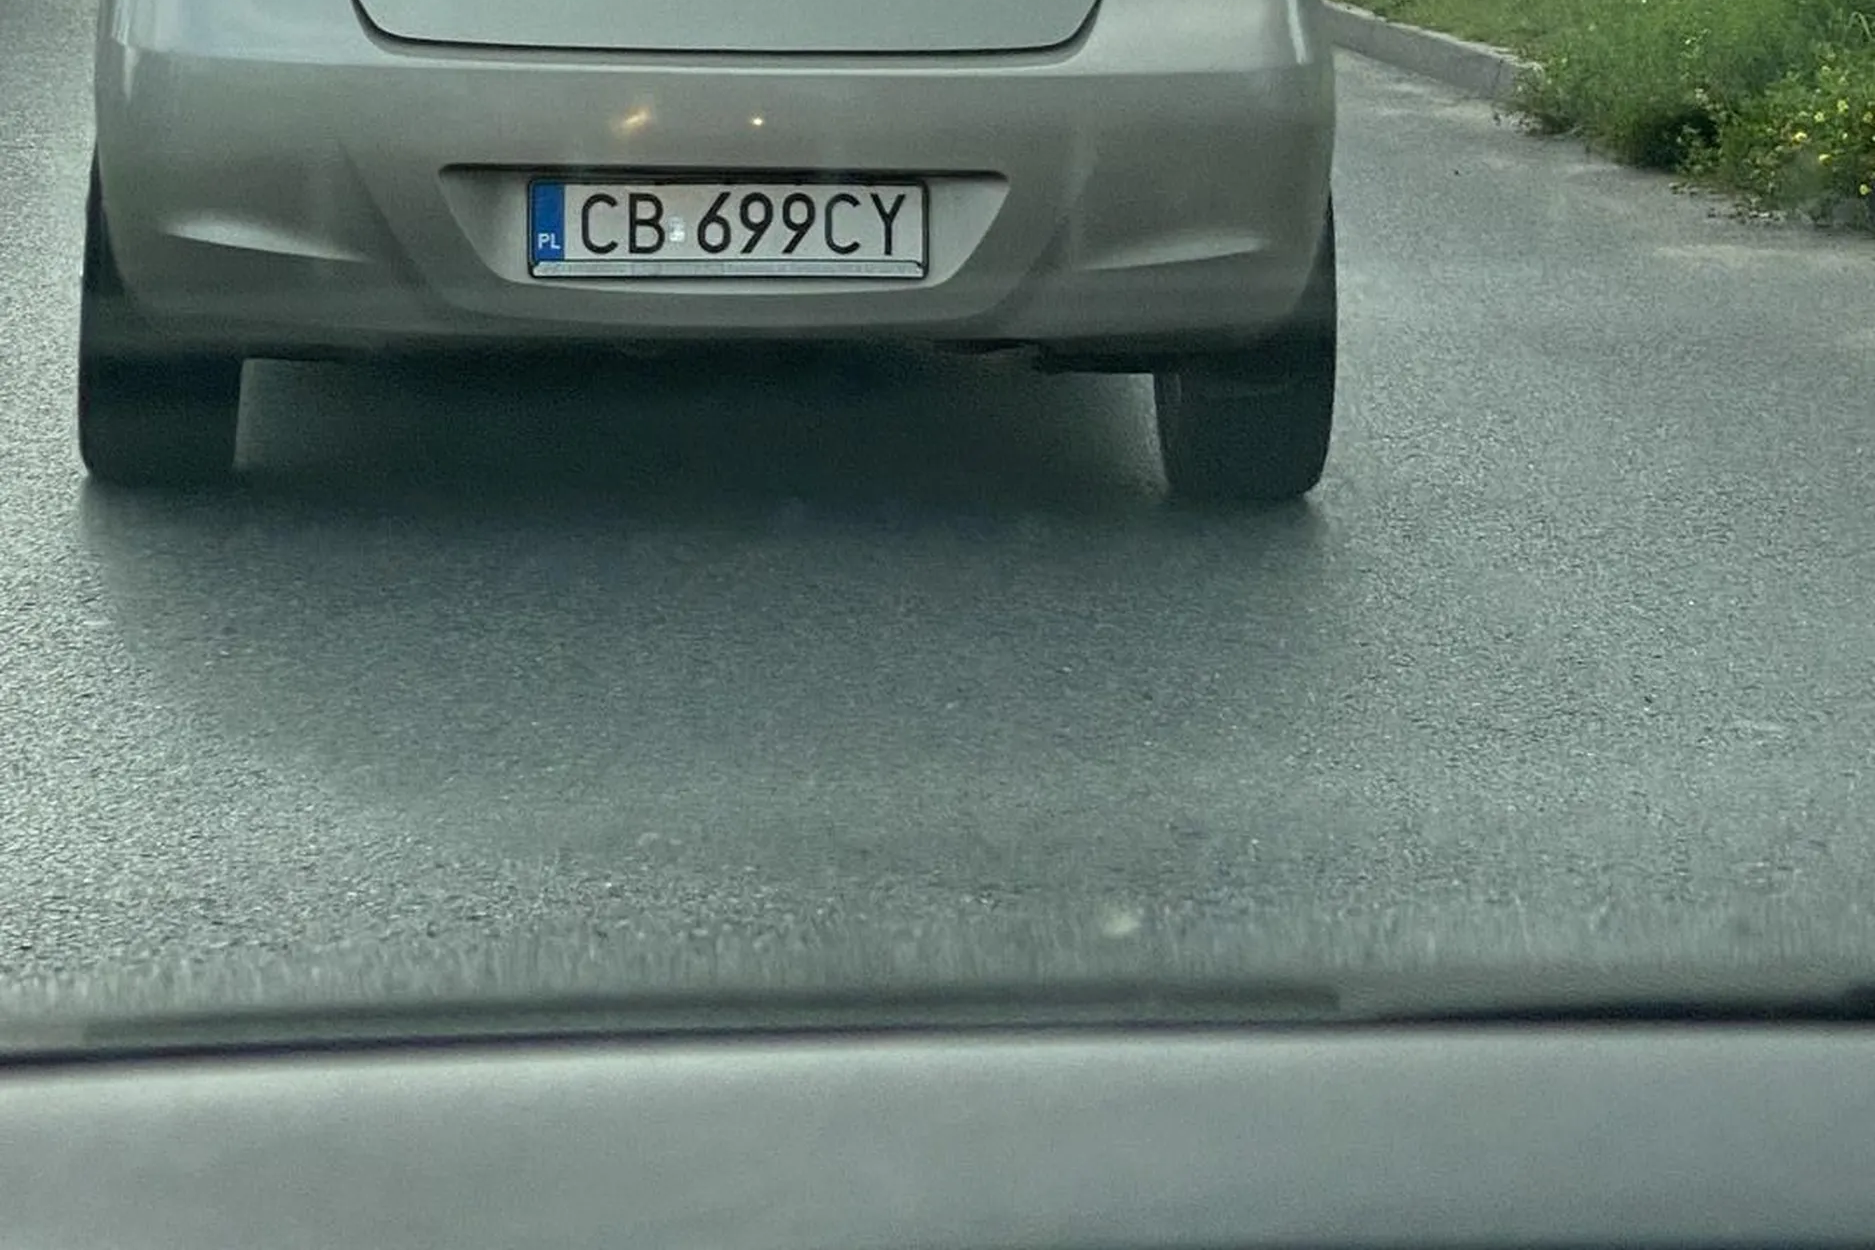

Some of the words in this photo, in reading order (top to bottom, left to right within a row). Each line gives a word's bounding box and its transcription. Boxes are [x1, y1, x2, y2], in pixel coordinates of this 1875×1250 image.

[538, 232, 560, 249] PL
[581, 193, 665, 254] CB
[697, 192, 906, 255] 699CY
